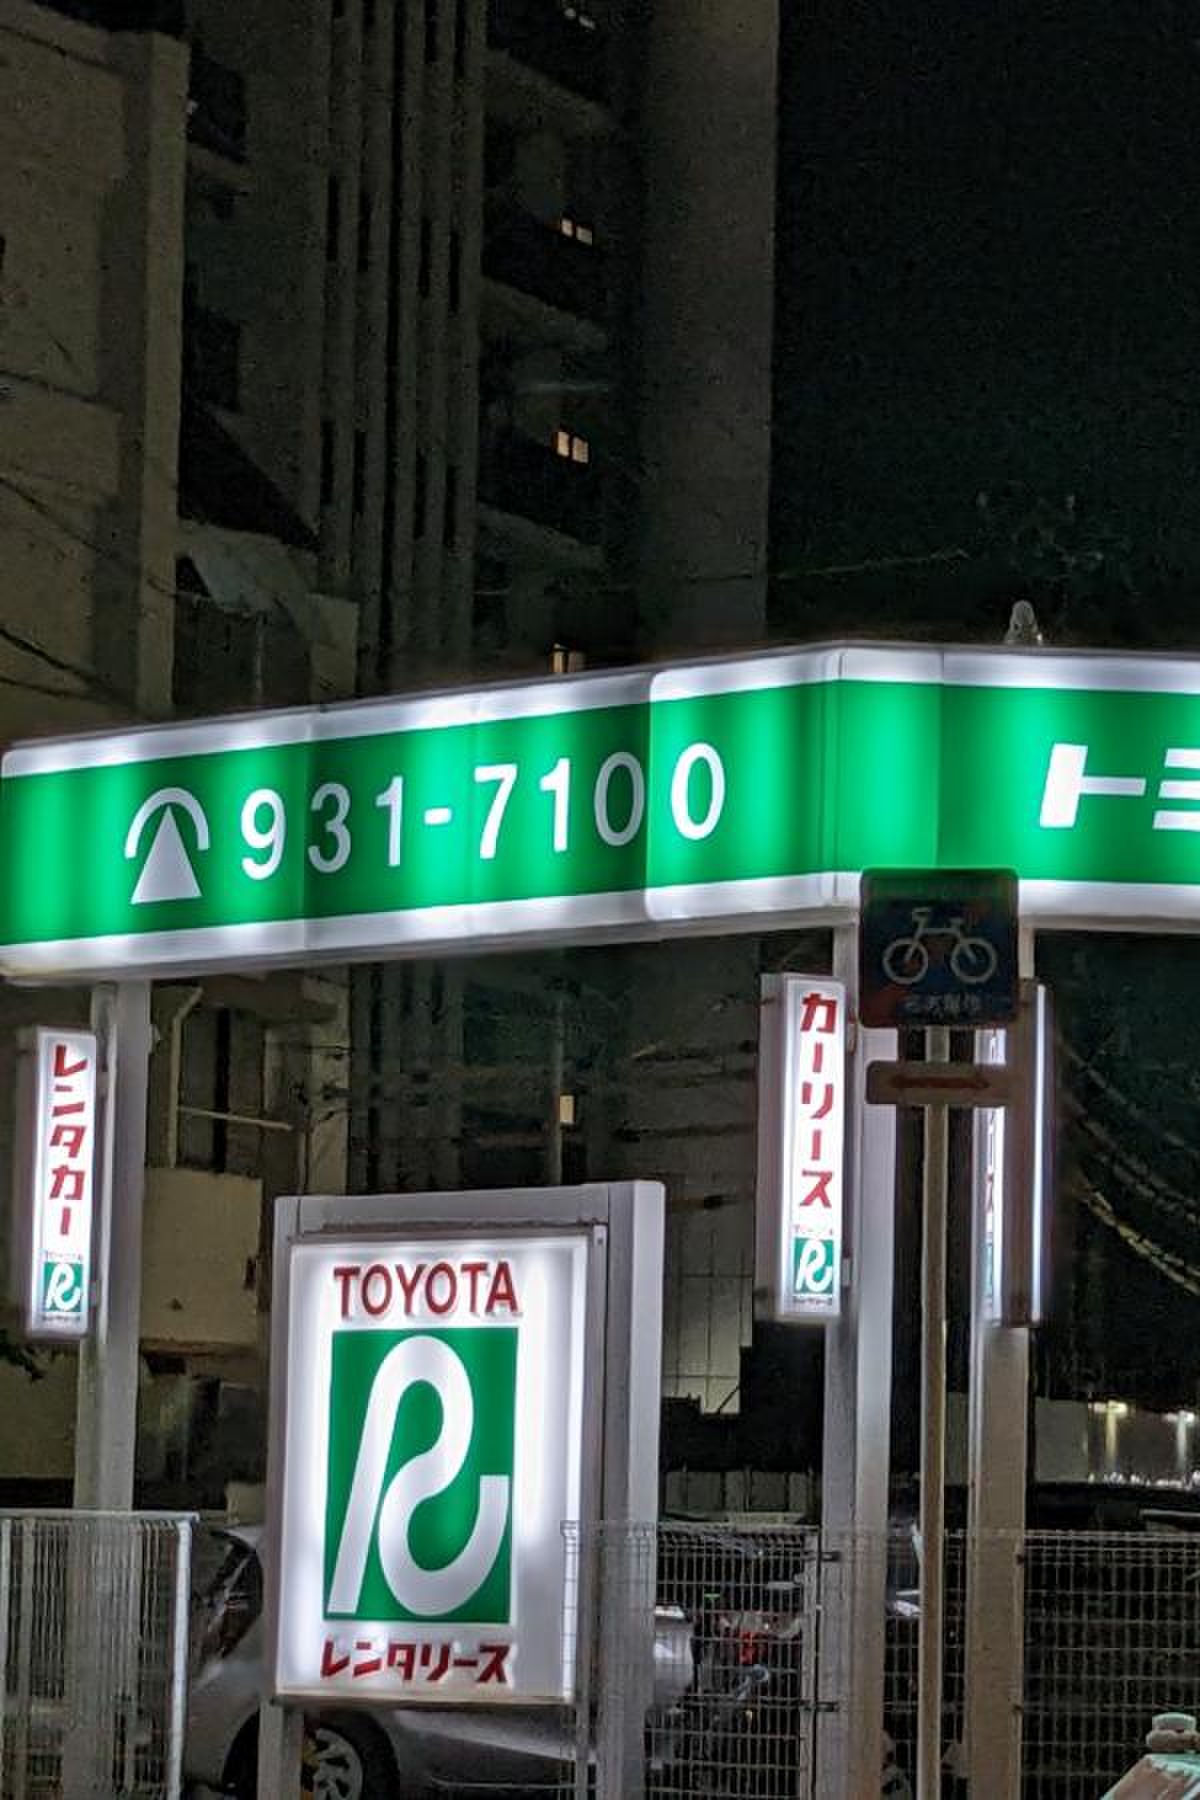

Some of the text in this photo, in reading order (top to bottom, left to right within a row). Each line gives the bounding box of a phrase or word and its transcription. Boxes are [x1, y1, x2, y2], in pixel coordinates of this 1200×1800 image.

[240, 742, 725, 881] 931-7100
[50, 1044, 88, 1235] レンタカー
[800, 992, 836, 1208] カーリース
[333, 1261, 519, 1319] TOYOTA
[319, 1640, 512, 1684] レンタリース
